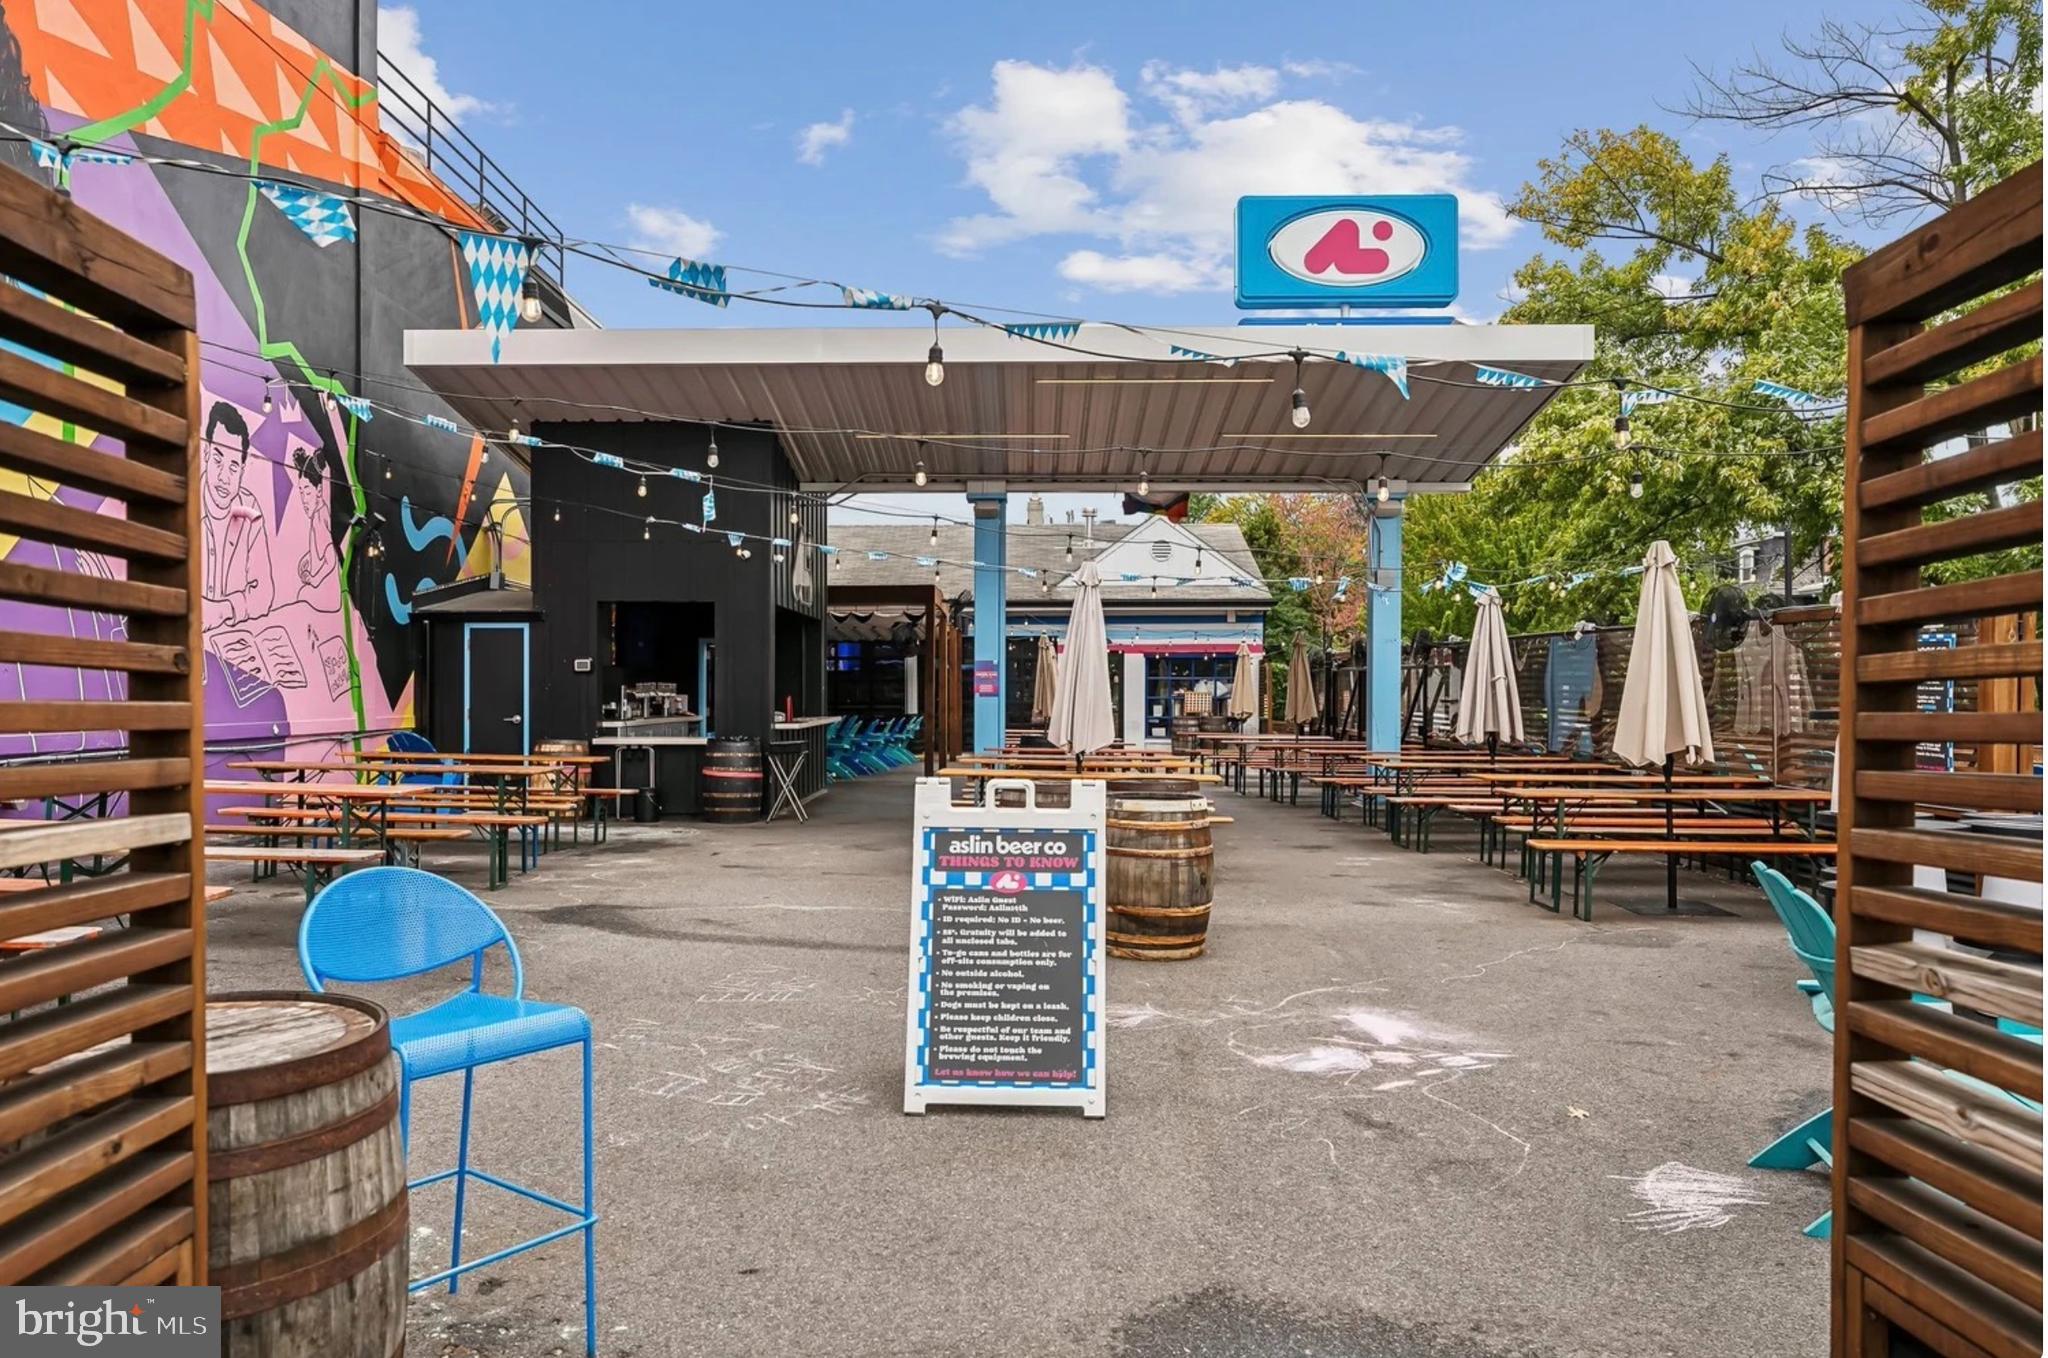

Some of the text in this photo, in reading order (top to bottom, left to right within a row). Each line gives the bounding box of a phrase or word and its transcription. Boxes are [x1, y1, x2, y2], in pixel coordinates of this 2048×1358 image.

[949, 834, 1067, 855] aslin beer co
[938, 855, 1080, 868] THINGS TO KNOW
[942, 904, 987, 912] Password:
[954, 916, 995, 924] required:
[1043, 917, 1065, 925] beer.
[959, 929, 997, 937] Gratuity
[942, 949, 967, 957] To-go
[976, 959, 1034, 967] consumption
[1035, 959, 1057, 968] only.
[989, 970, 1024, 978] alcohol.
[955, 982, 993, 990] smoking
[1007, 983, 1037, 991] vaping
[956, 990, 999, 998] premises.
[940, 1001, 962, 1009] Dogs
[1001, 1002, 1021, 1010] kept
[1043, 1002, 1069, 1010] leash.
[970, 1014, 991, 1023] keep
[993, 1014, 1031, 1022] children
[1032, 1015, 1058, 1023] close.
[953, 1026, 998, 1035] respectful
[1054, 1027, 1071, 1035] and
[939, 1033, 963, 1041] other
[965, 1034, 997, 1042] guests.
[999, 1034, 1021, 1043] Keep
[1031, 1034, 1071, 1043] friendly.
[939, 1046, 968, 1054] Please
[969, 1046, 981, 1054] do
[1028, 1047, 1042, 1055] the
[939, 1053, 1028, 1062] brewing equipment.
[934, 1068, 951, 1076] Let
[966, 1068, 993, 1077] know
[994, 1069, 1015, 1077] how
[1052, 1069, 1077, 1079] help!
